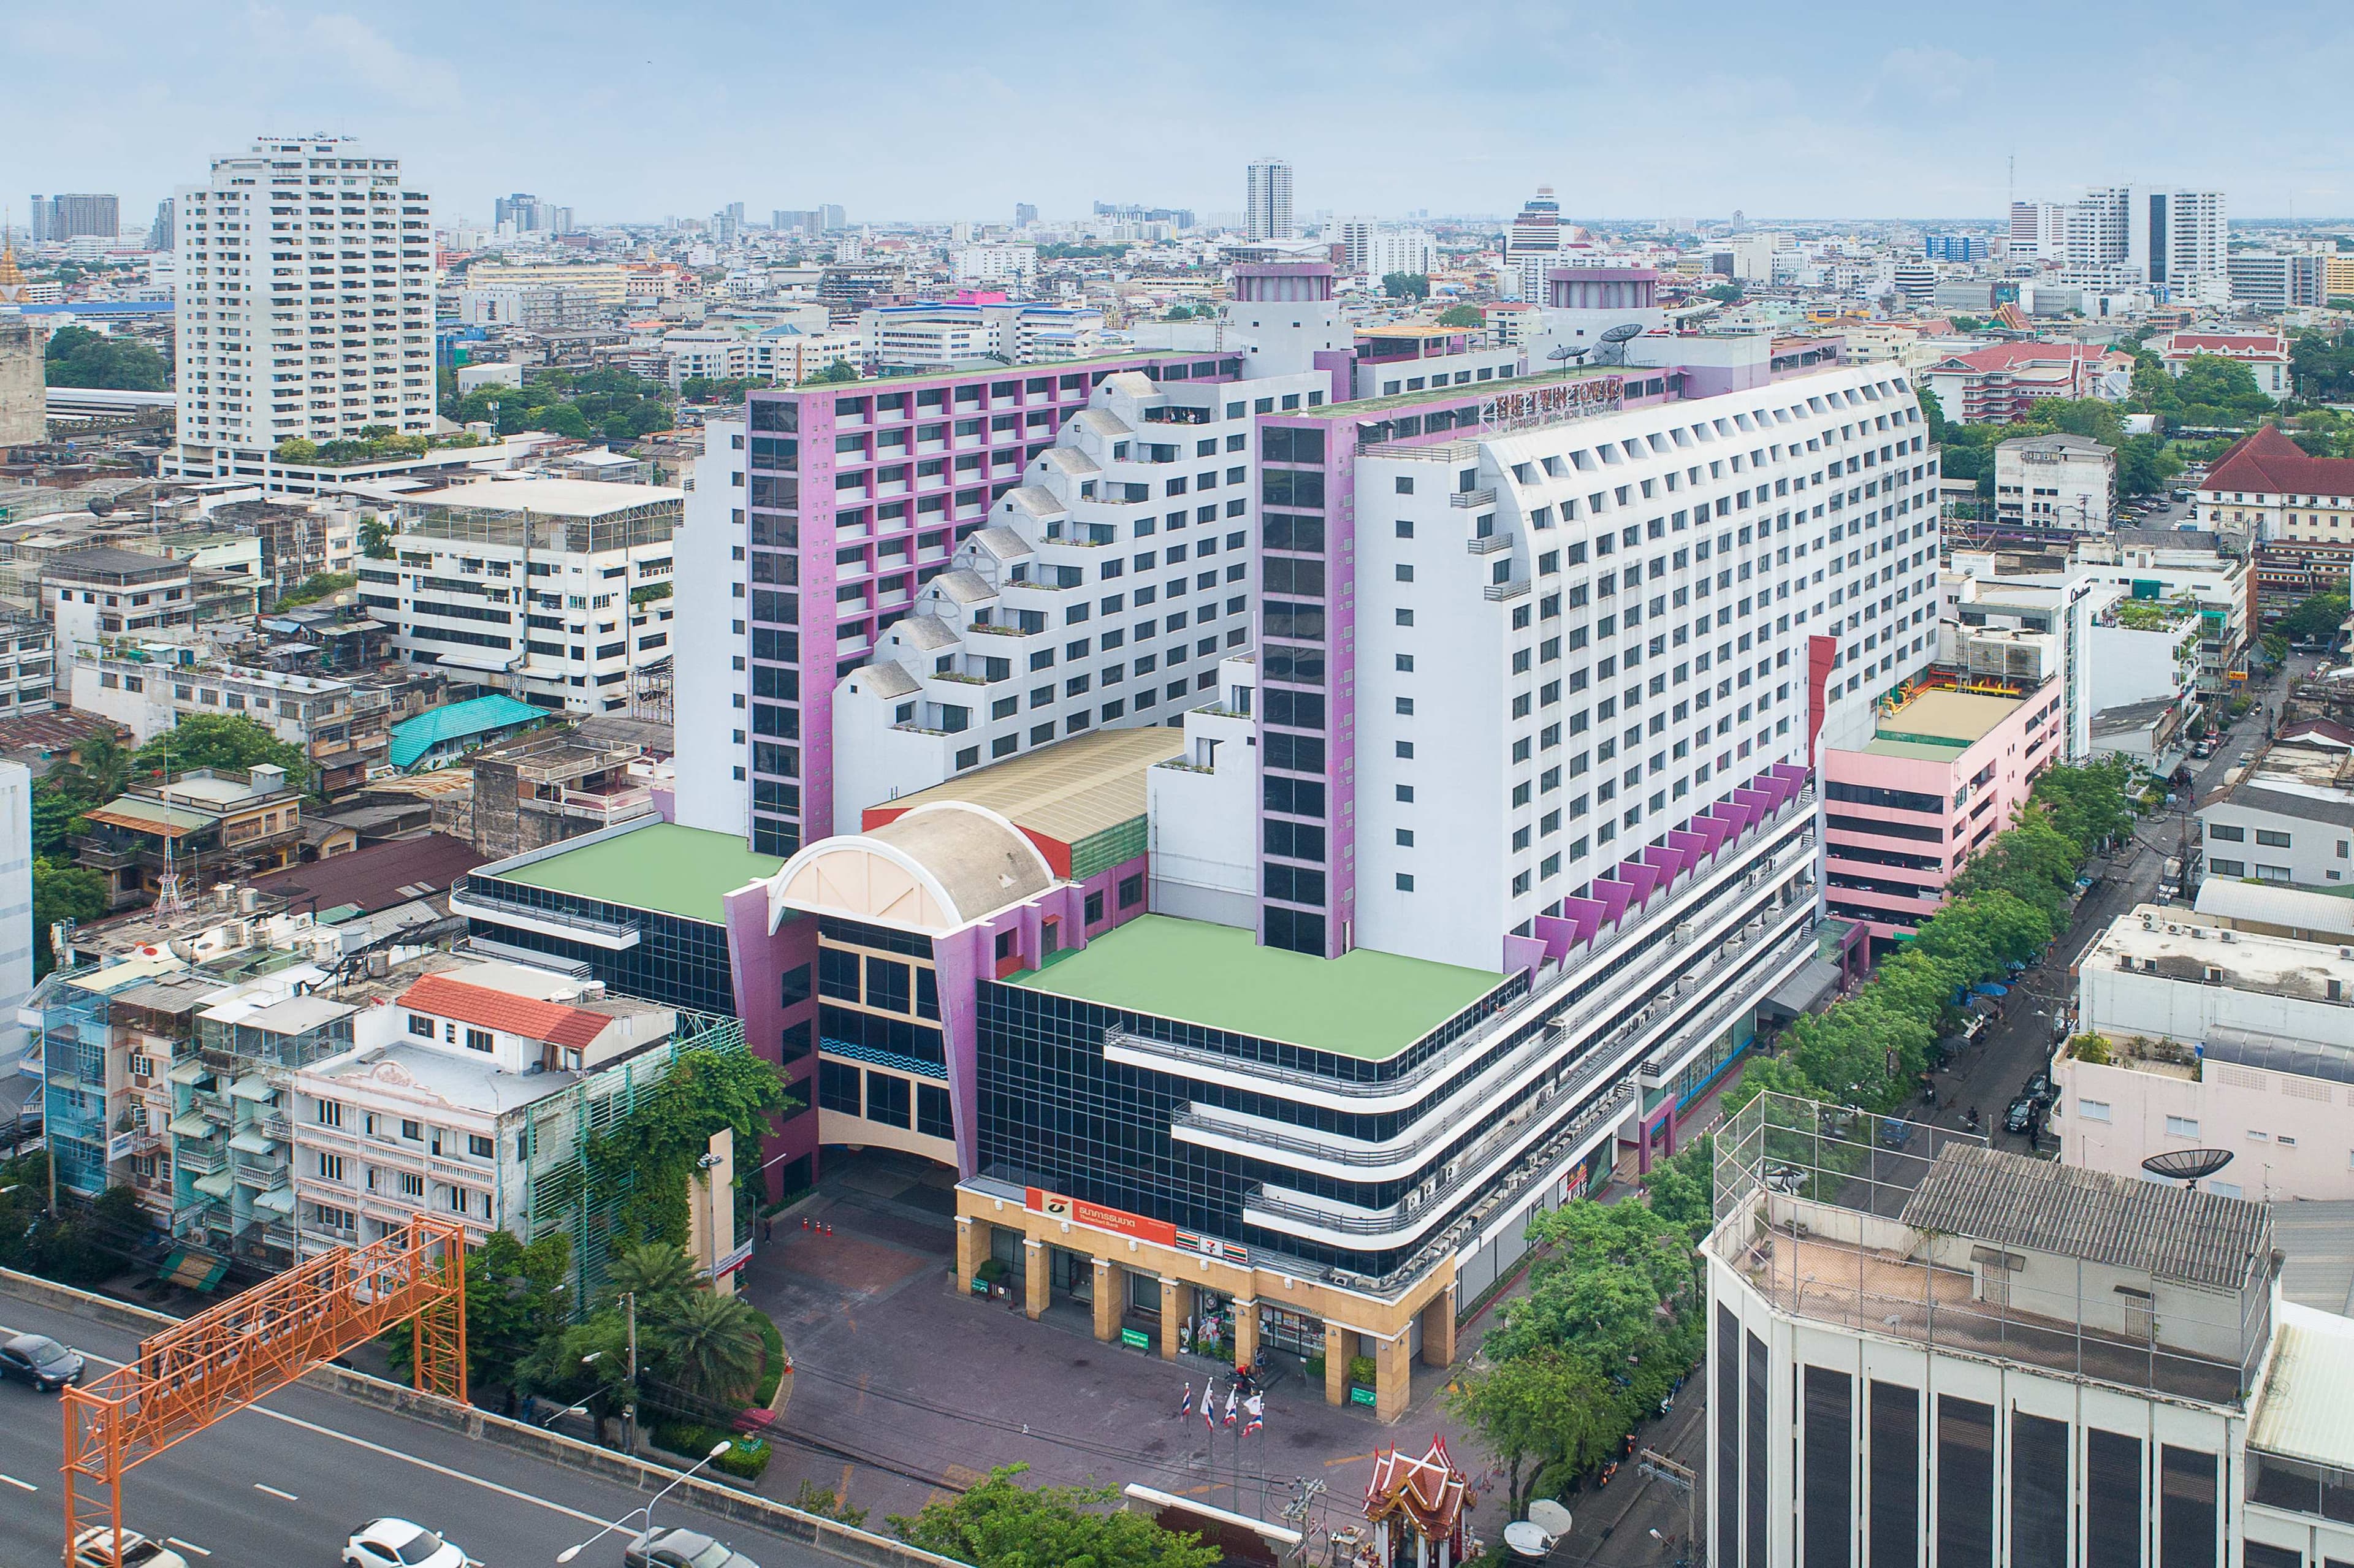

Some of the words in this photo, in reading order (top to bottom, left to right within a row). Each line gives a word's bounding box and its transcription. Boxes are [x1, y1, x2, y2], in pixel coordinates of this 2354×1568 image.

[1496, 394, 1524, 419] THE
[1530, 386, 1567, 413] TWIN
[1572, 377, 1624, 403] TOWERS
[1079, 1206, 1135, 1228] ธนาคารธนชาต
